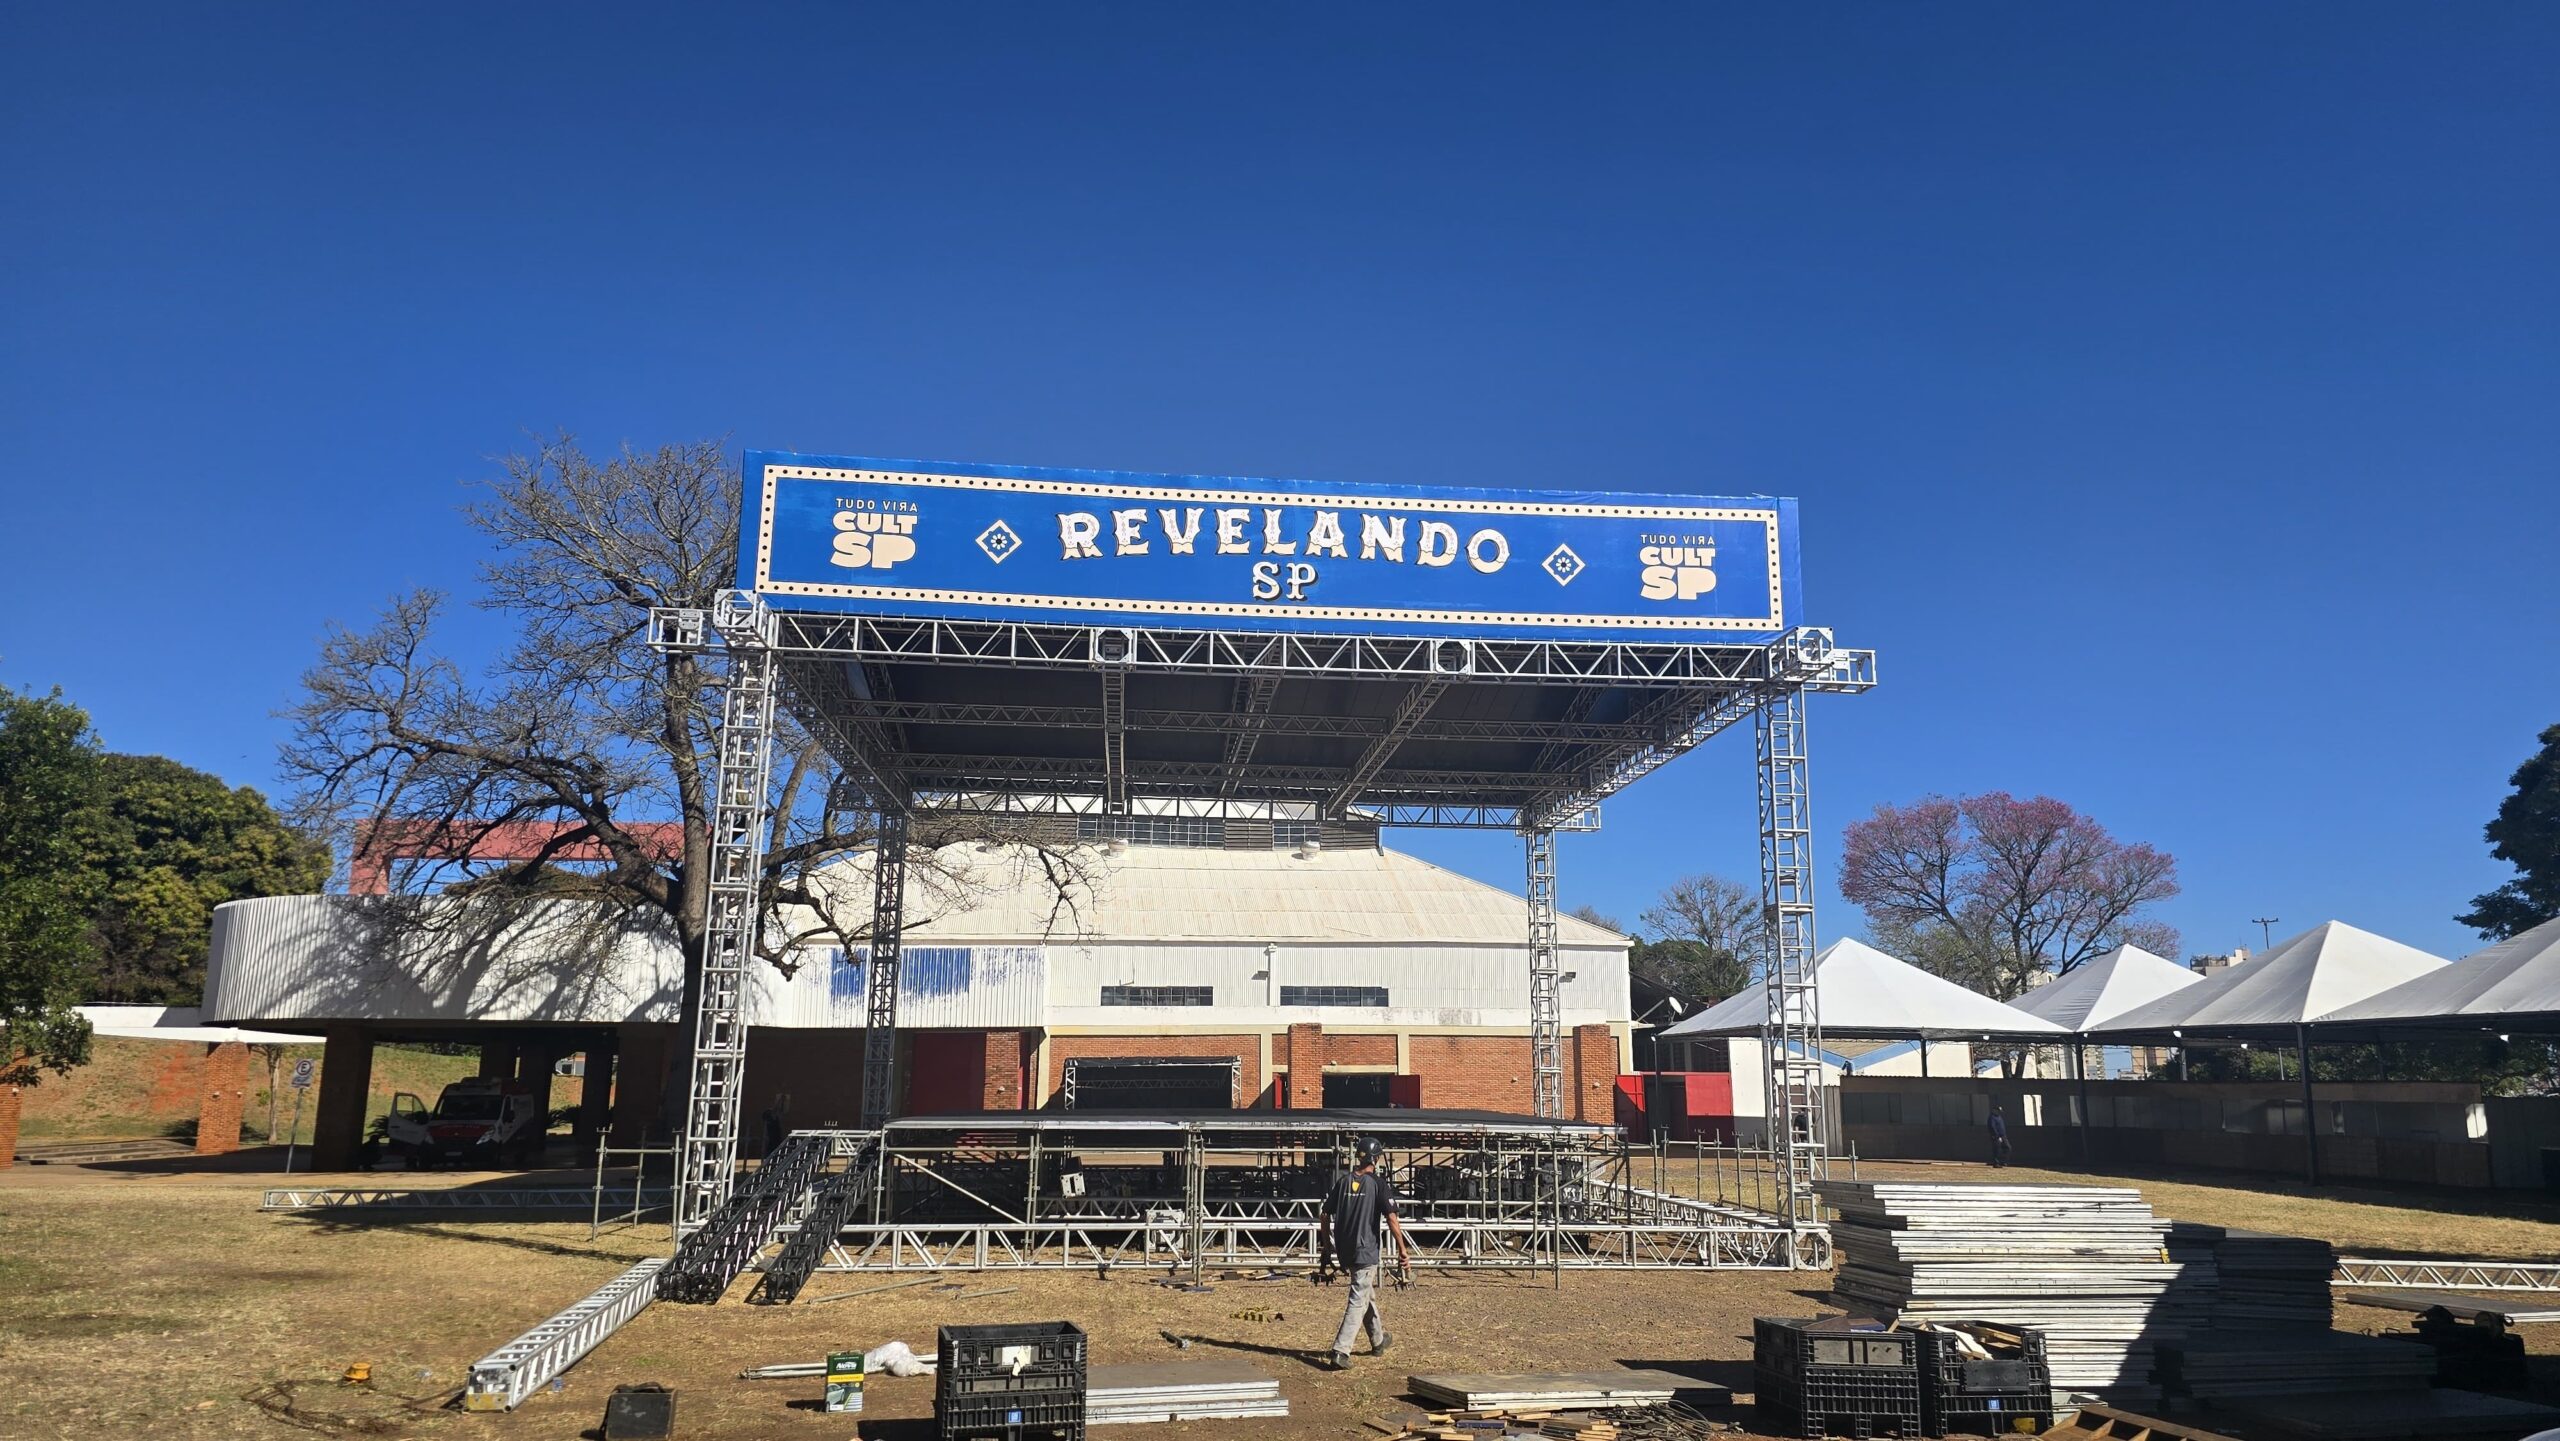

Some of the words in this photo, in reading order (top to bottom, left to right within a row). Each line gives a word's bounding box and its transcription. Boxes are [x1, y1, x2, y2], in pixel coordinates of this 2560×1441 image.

[836, 498, 875, 510] TUDO
[833, 511, 918, 535] CULT
[830, 531, 916, 569] SP
[1056, 507, 1511, 574] REVELANDO
[1640, 534, 1677, 545] TUDO
[1639, 546, 1716, 567] CULT
[1252, 561, 1318, 601] SP
[1640, 565, 1717, 601] SP
